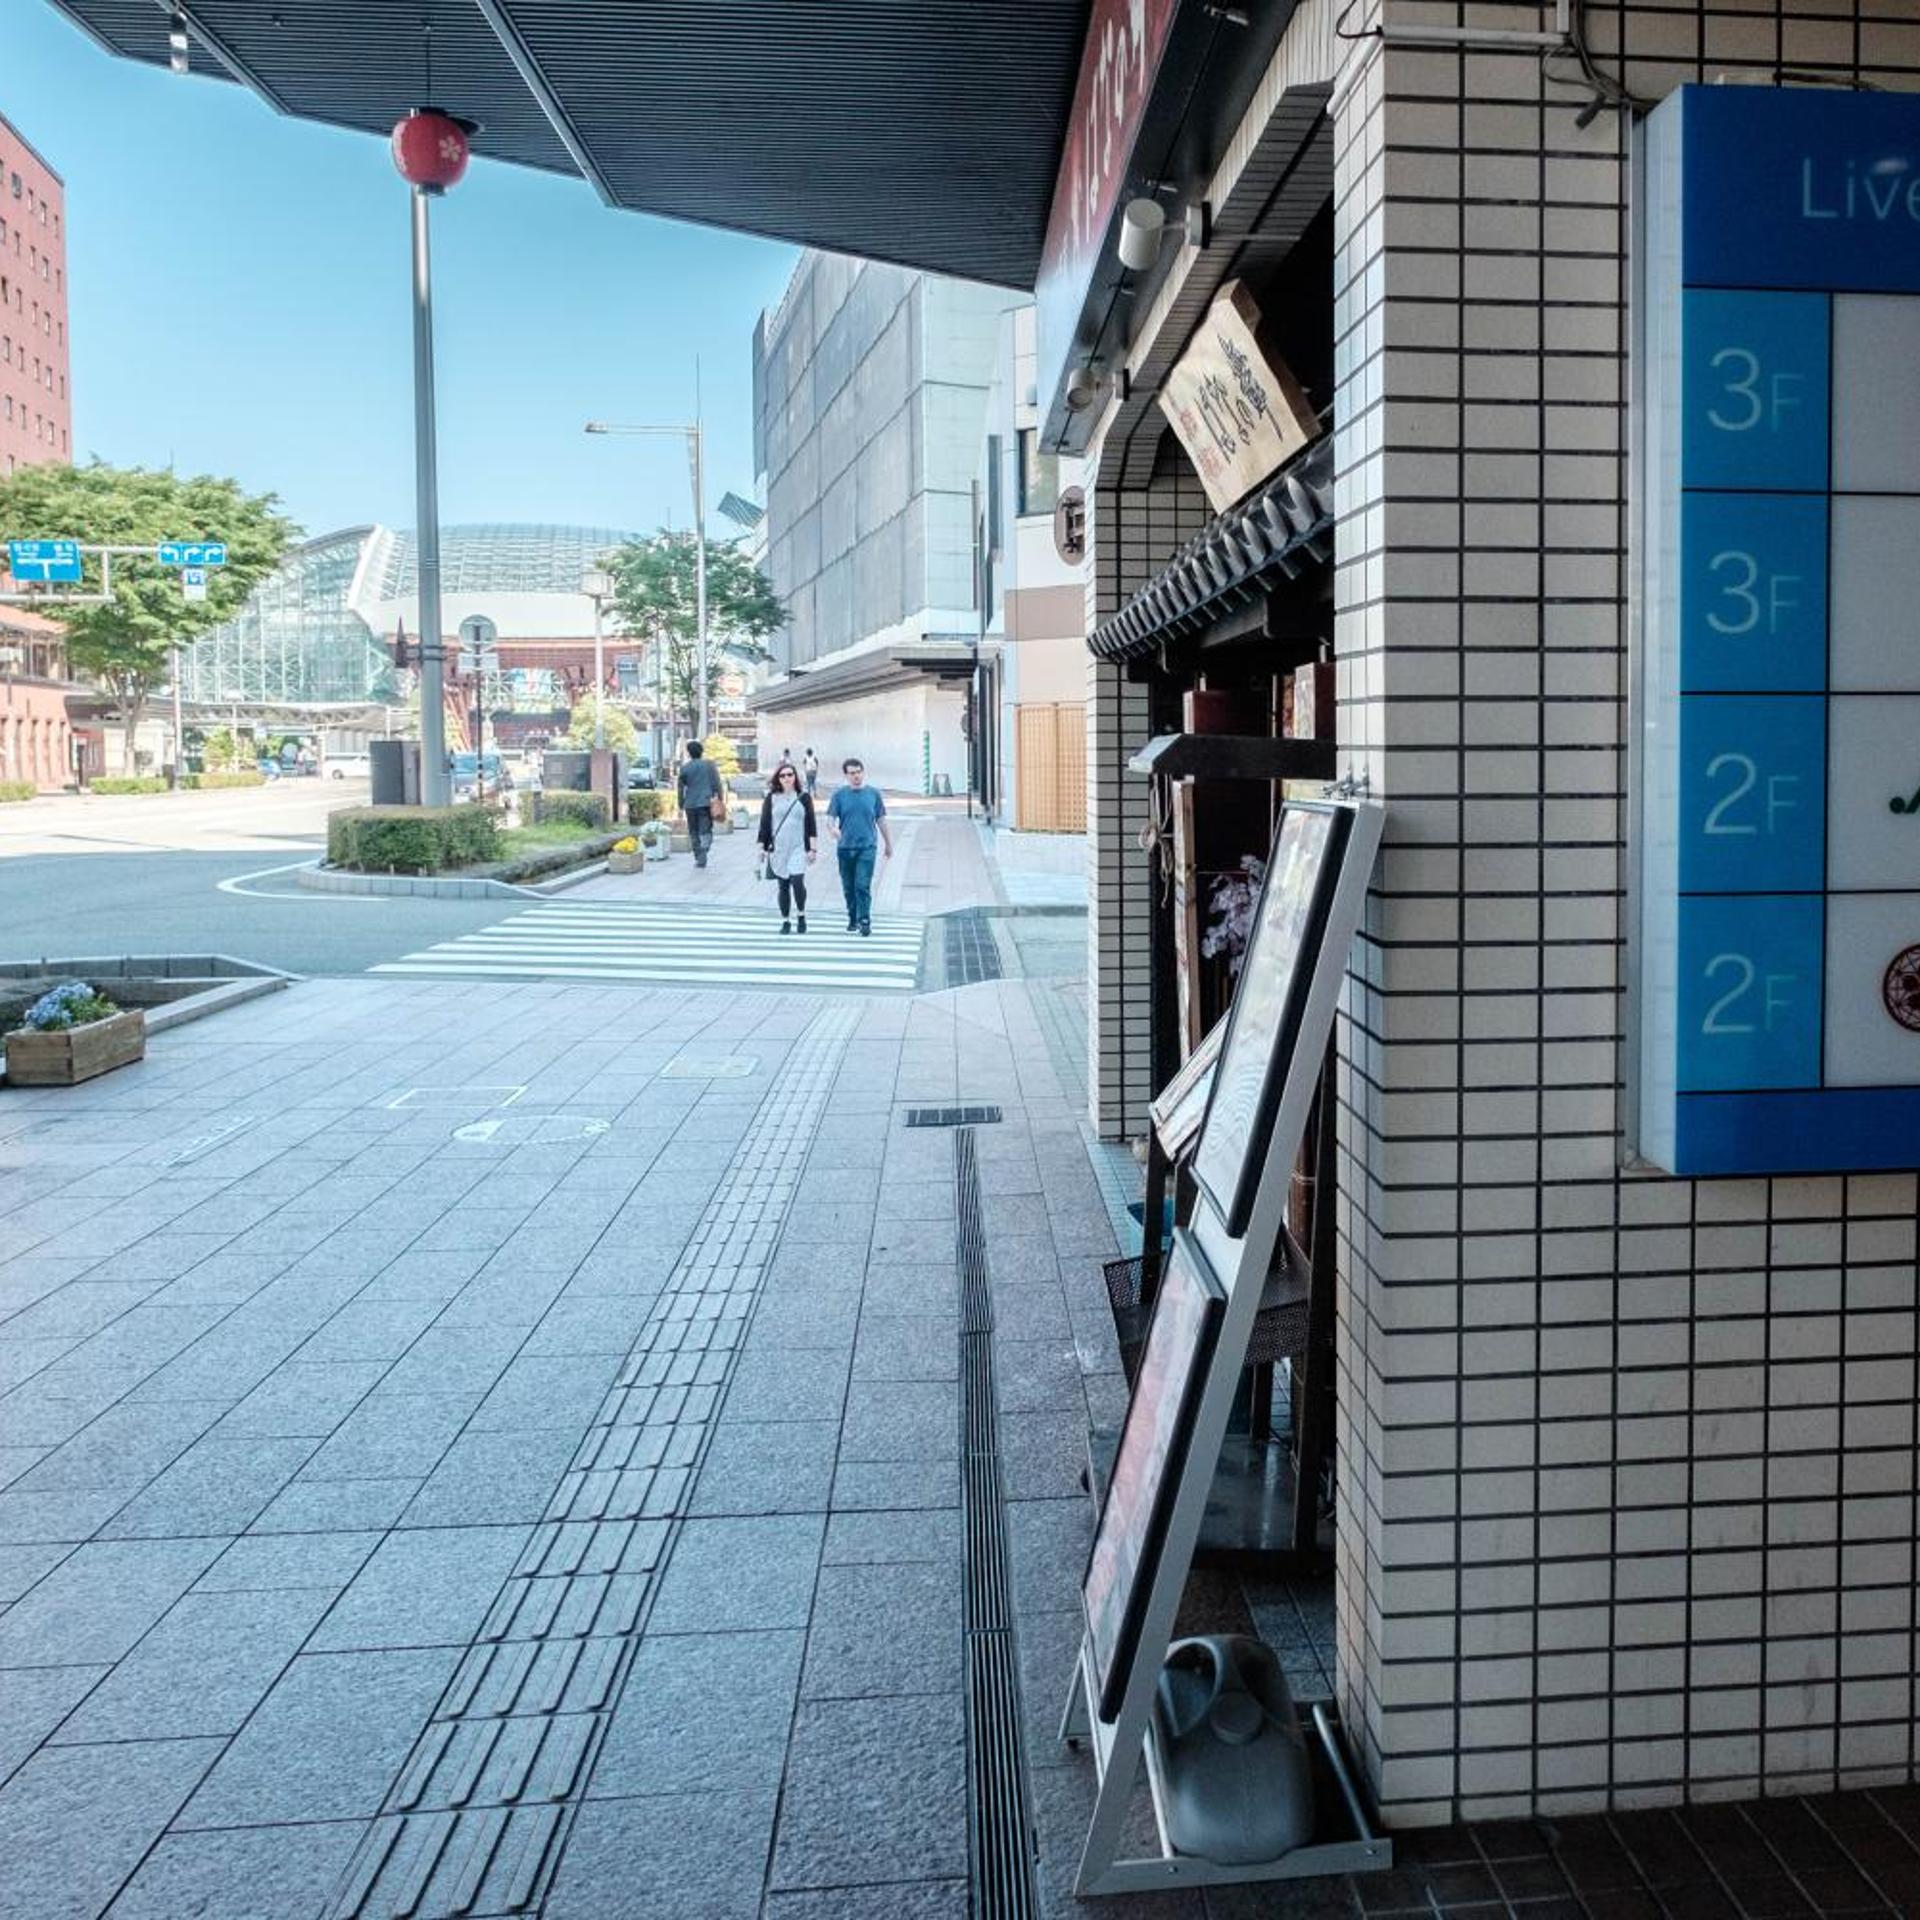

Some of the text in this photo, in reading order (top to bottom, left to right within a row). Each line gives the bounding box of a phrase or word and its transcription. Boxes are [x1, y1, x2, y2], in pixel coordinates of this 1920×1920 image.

[1707, 348, 1805, 432] 3F
[1706, 551, 1804, 634] 3F
[1703, 753, 1799, 834] 2F
[1702, 953, 1797, 1033] 2F
